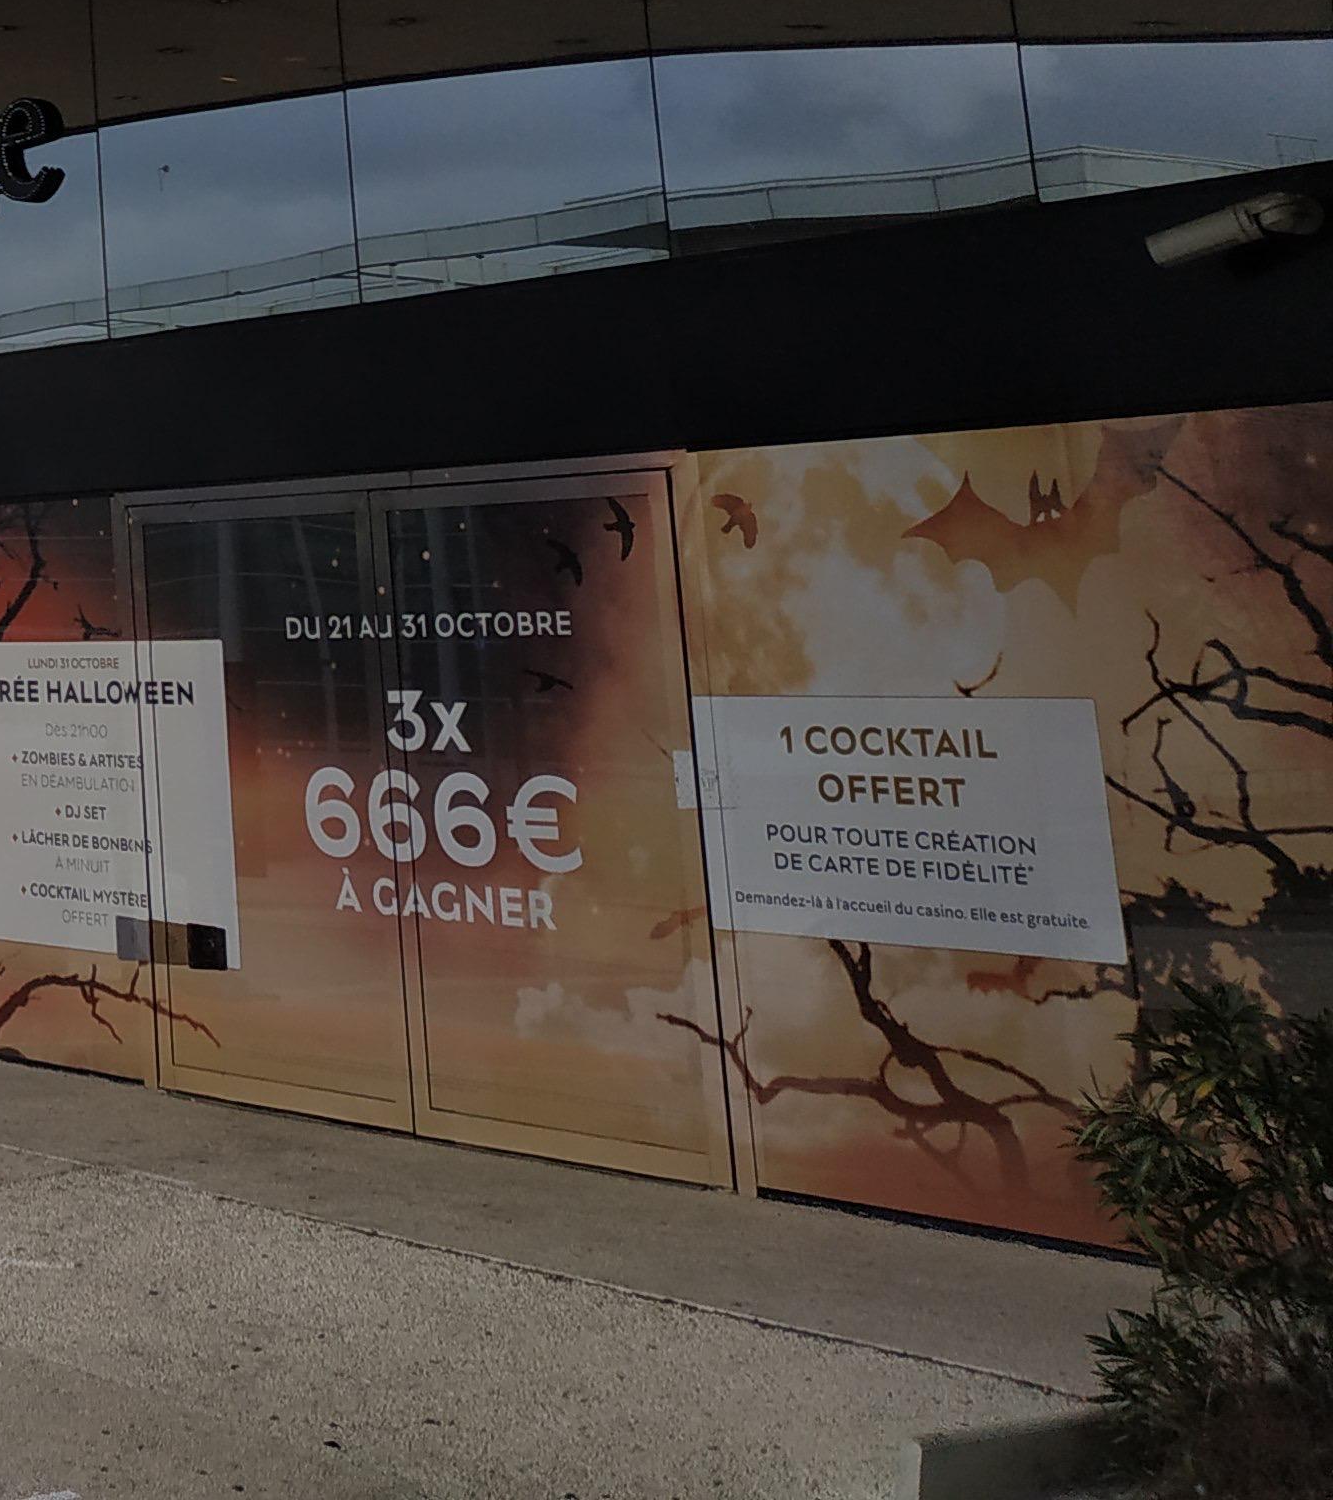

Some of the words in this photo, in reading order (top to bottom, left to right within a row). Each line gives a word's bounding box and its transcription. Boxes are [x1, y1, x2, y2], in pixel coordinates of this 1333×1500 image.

[285, 616, 321, 640] DU
[328, 615, 353, 640] 21
[359, 614, 392, 639] AU
[401, 612, 428, 639] 31
[434, 610, 573, 637] OCTOBRE
[28, 657, 58, 669] LUNDI
[60, 657, 69, 669] 31
[71, 657, 119, 669] OCTOBRE
[46, 679, 195, 706] HALLOWEEN
[386, 689, 473, 753] 3x
[779, 726, 793, 754] 1
[803, 725, 998, 759] COCKTAIL
[21, 750, 76, 766] ZOMBIES
[78, 753, 88, 767] &
[21, 773, 38, 787] EN
[817, 772, 966, 808] OFFERT
[65, 805, 81, 820] DJ
[83, 805, 107, 821] SET
[304, 766, 584, 874] 666€
[21, 828, 70, 848] LÂCHER
[73, 836, 90, 849] DE
[766, 823, 828, 845] POUR
[831, 827, 909, 850] TOUTE
[914, 829, 1037, 856] CRÉATION
[66, 857, 110, 873] MINUIT
[774, 851, 803, 871] DE
[808, 854, 880, 876] CARTE
[885, 858, 917, 879] DE
[30, 883, 90, 903] COCKTAIL
[335, 866, 363, 913] À
[372, 877, 558, 931] GAGNER
[62, 908, 109, 926] OFFERT
[735, 890, 823, 909] Demandez-là
[826, 896, 834, 910] à
[836, 896, 892, 914] l'accueil
[894, 901, 913, 916] du
[916, 903, 967, 920] casino.
[970, 908, 997, 922] Elle
[1000, 911, 1024, 925] est
